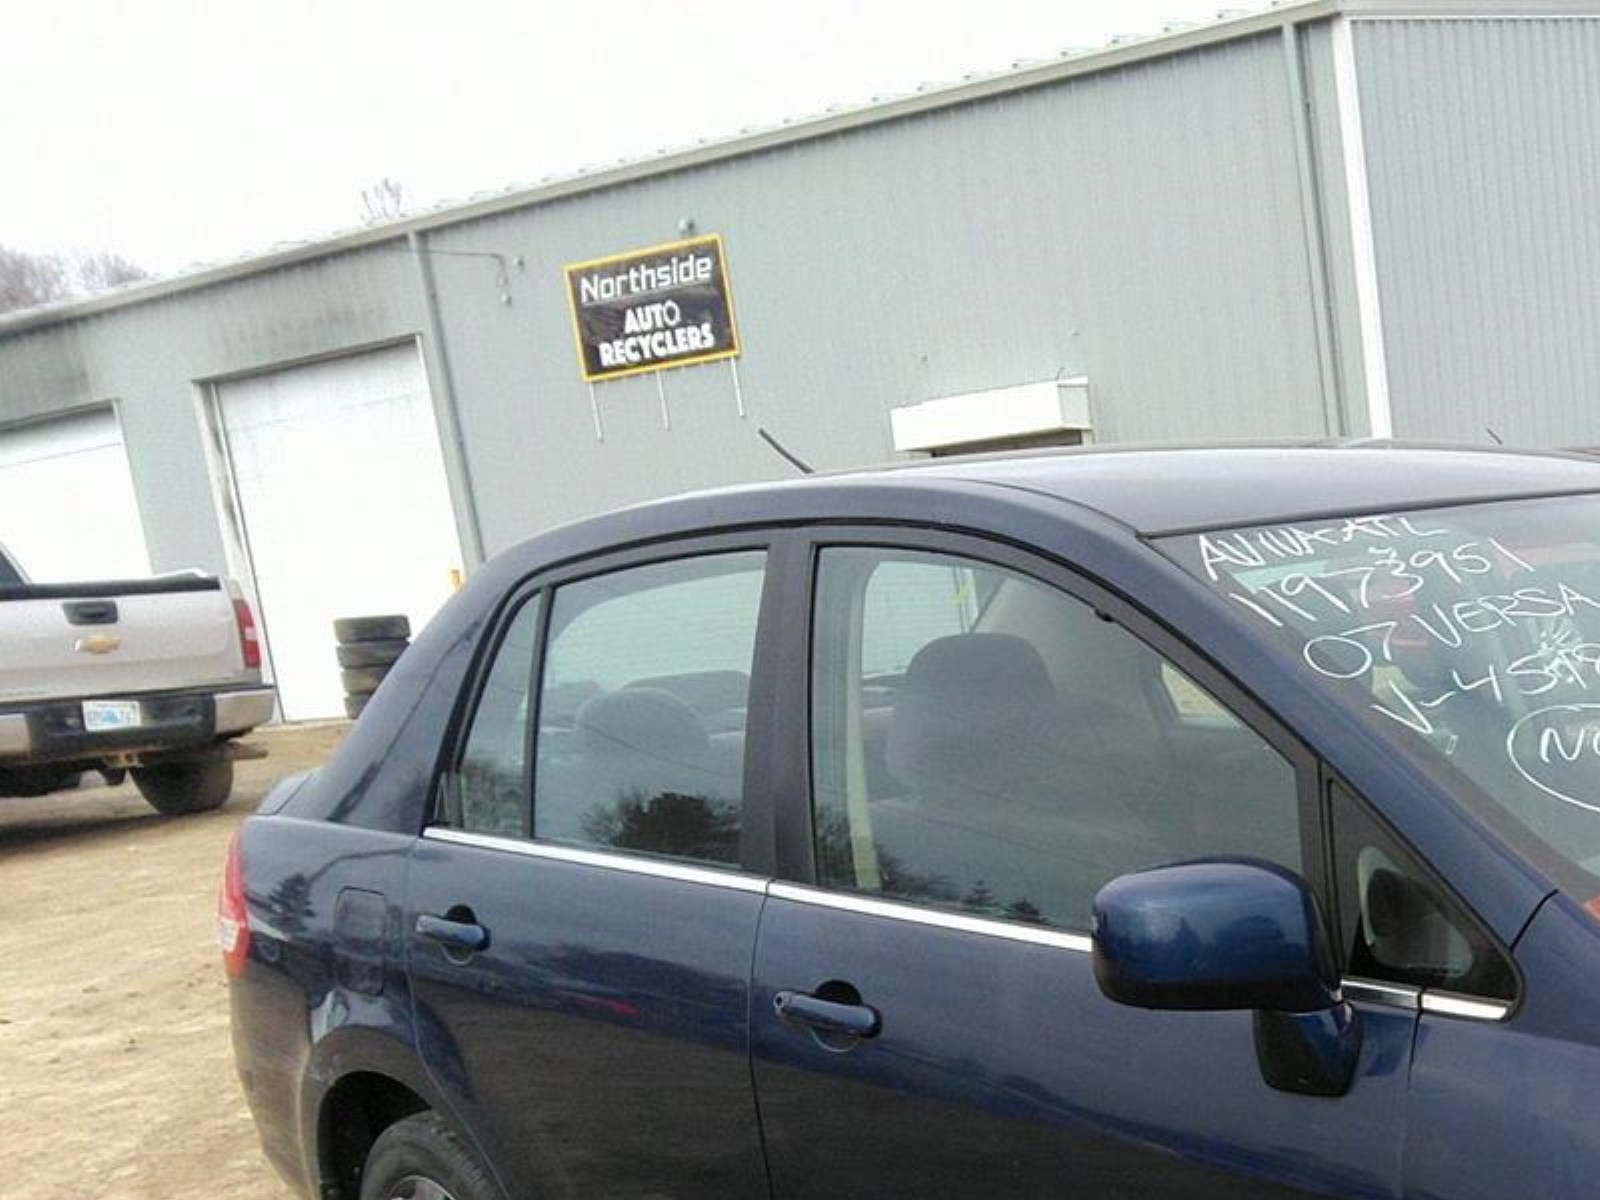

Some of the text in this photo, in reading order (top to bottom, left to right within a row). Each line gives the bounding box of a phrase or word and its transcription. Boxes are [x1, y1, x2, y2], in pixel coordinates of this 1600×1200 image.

[580, 253, 713, 304] Northside
[624, 299, 681, 334] AUTO
[599, 322, 715, 367] RECYCLERS
[1228, 536, 1536, 628] 11973951
[1302, 620, 1399, 679] 07
